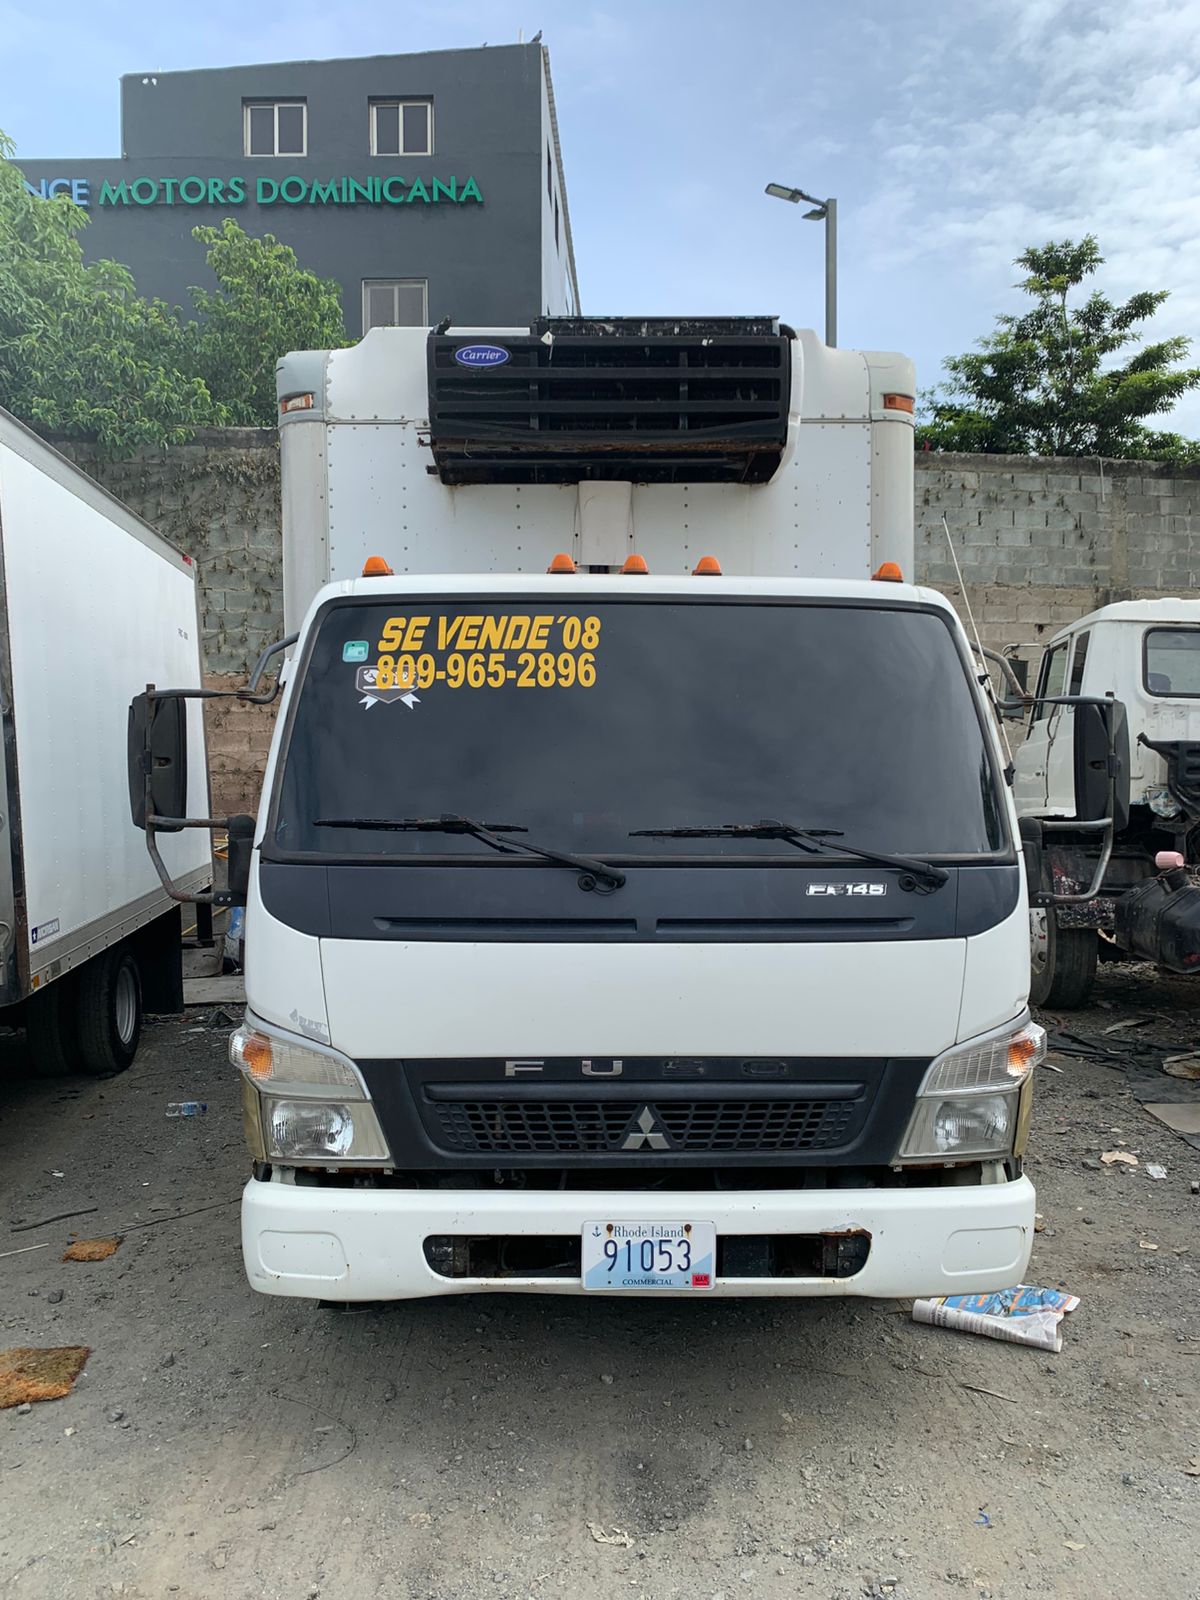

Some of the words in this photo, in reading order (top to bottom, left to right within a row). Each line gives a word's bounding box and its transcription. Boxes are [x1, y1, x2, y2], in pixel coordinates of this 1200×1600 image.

[99, 176, 247, 205] MOTORS
[255, 175, 484, 204] DOMINICANA
[462, 350, 501, 360] Carrier
[377, 616, 431, 652] SE
[376, 652, 597, 689] 809-965-2896
[614, 1226, 648, 1237] Rhode
[651, 1226, 684, 1237] Island
[604, 1239, 691, 1272] 91053
